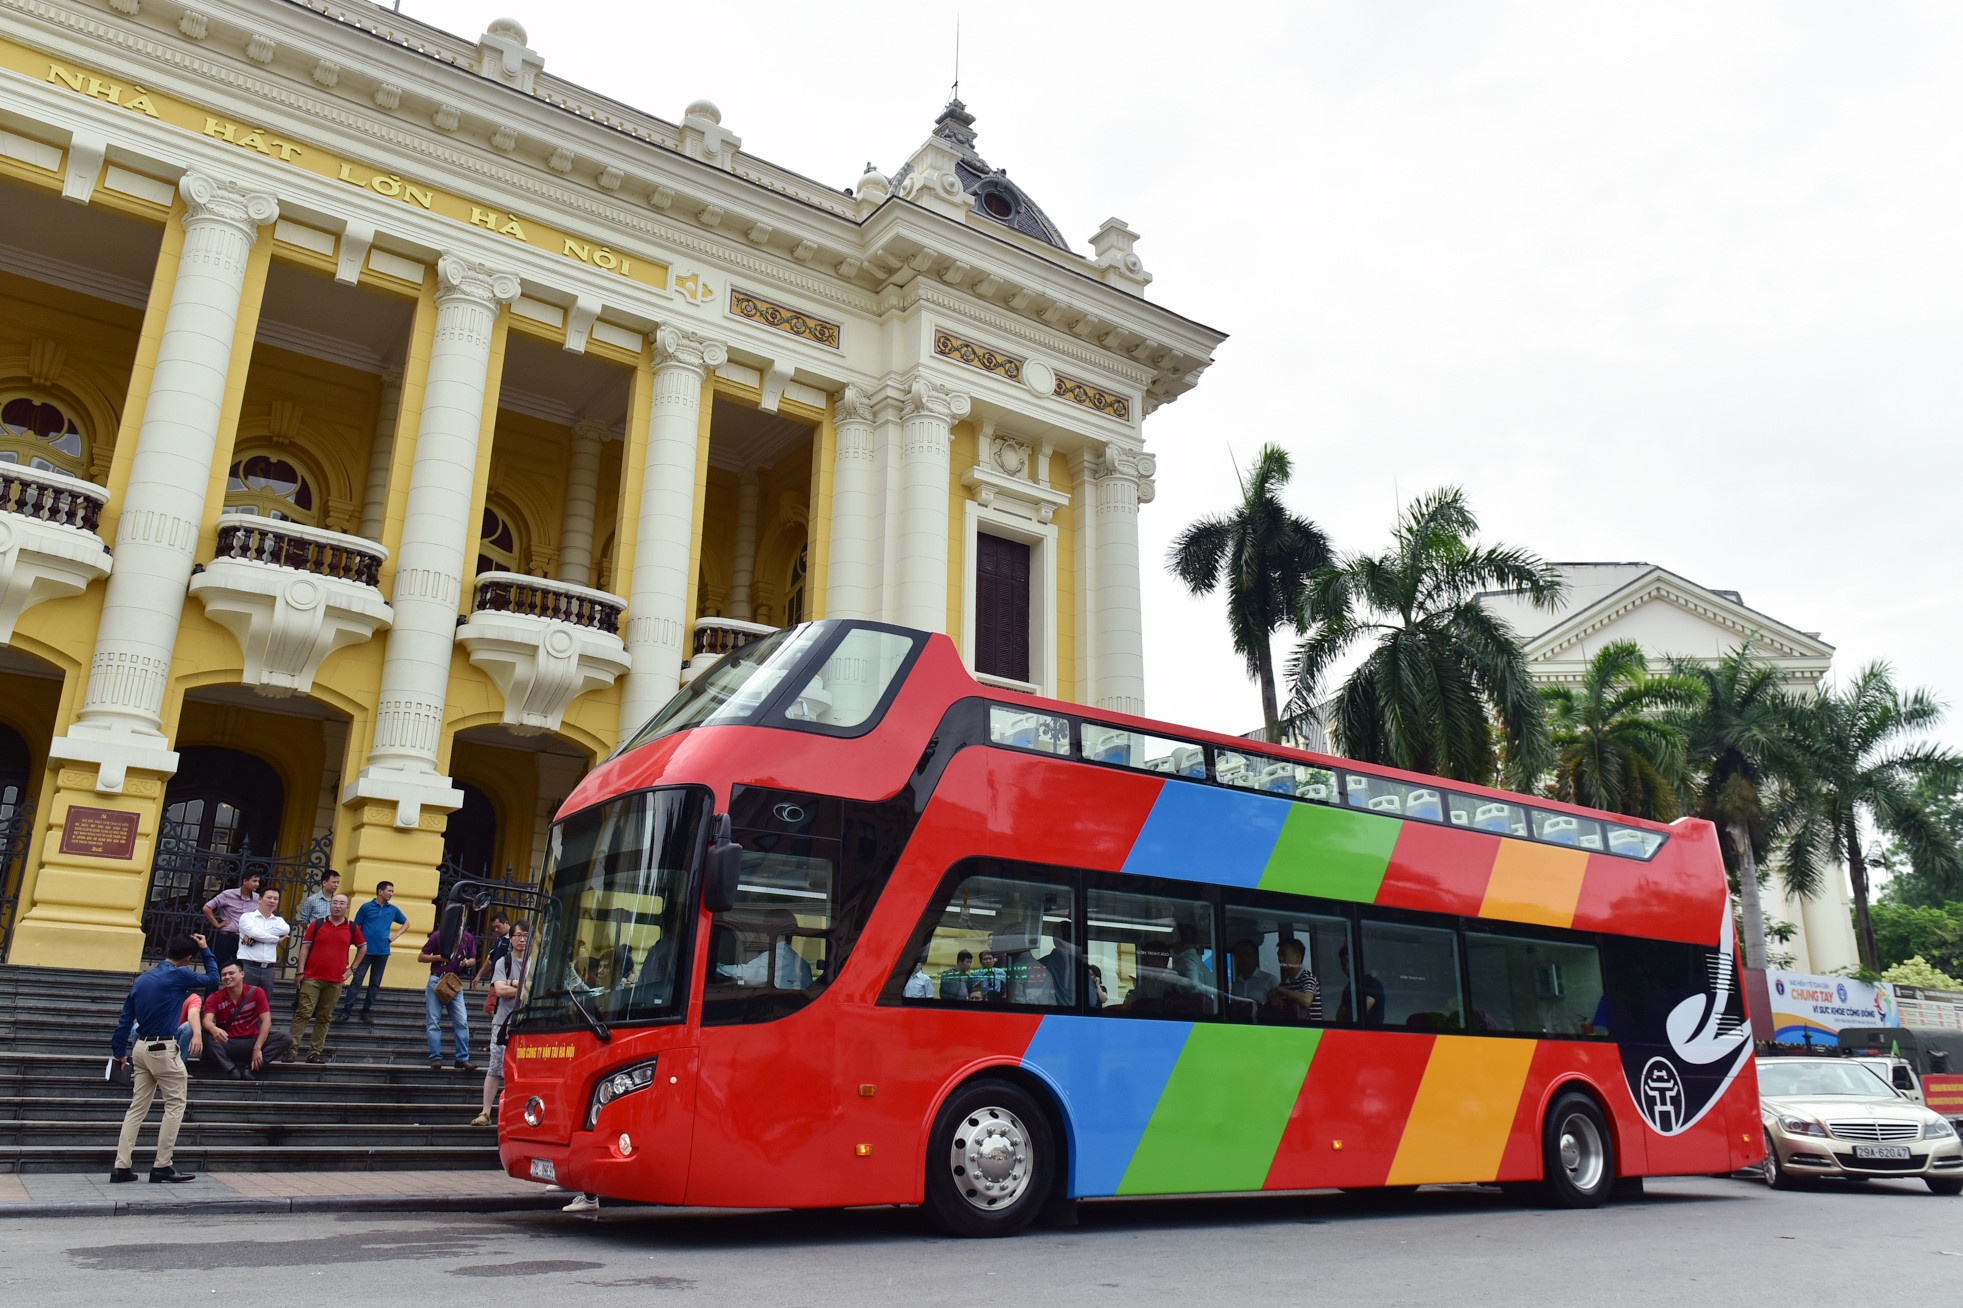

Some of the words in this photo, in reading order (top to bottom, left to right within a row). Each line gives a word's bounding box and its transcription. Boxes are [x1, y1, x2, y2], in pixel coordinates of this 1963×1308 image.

[46, 64, 160, 118] NHÀ
[203, 117, 301, 161] HÁT
[470, 207, 527, 241] HÀ
[563, 239, 631, 276] NỘI
[1791, 988, 1819, 1002] CHUNG
[1819, 990, 1834, 1003] TAY
